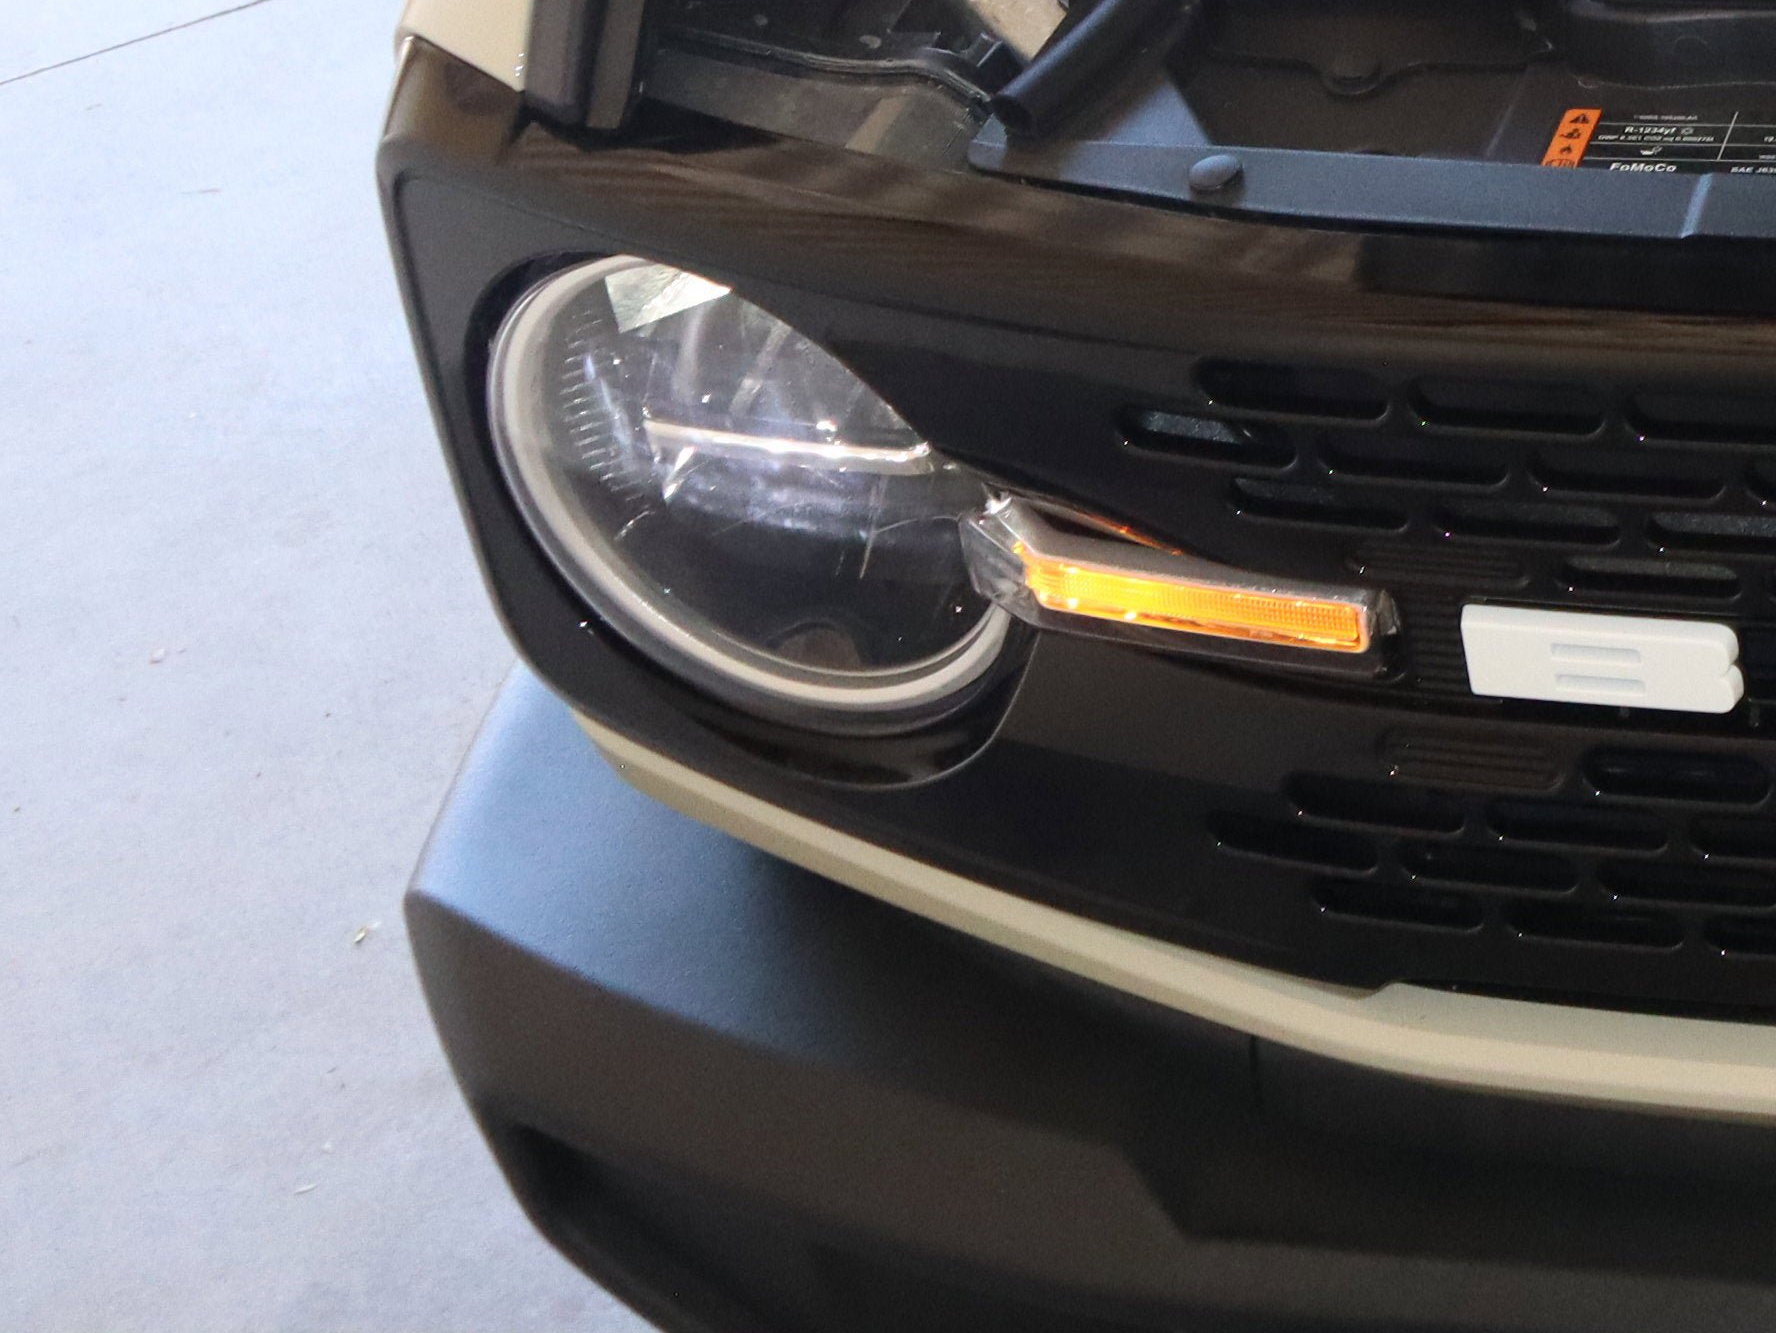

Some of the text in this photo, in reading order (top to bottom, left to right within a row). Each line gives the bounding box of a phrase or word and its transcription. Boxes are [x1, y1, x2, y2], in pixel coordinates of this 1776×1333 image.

[1624, 126, 1677, 136] R-1234yf
[1609, 162, 1677, 172] FoMoCo
[1730, 166, 1753, 174] SAE
